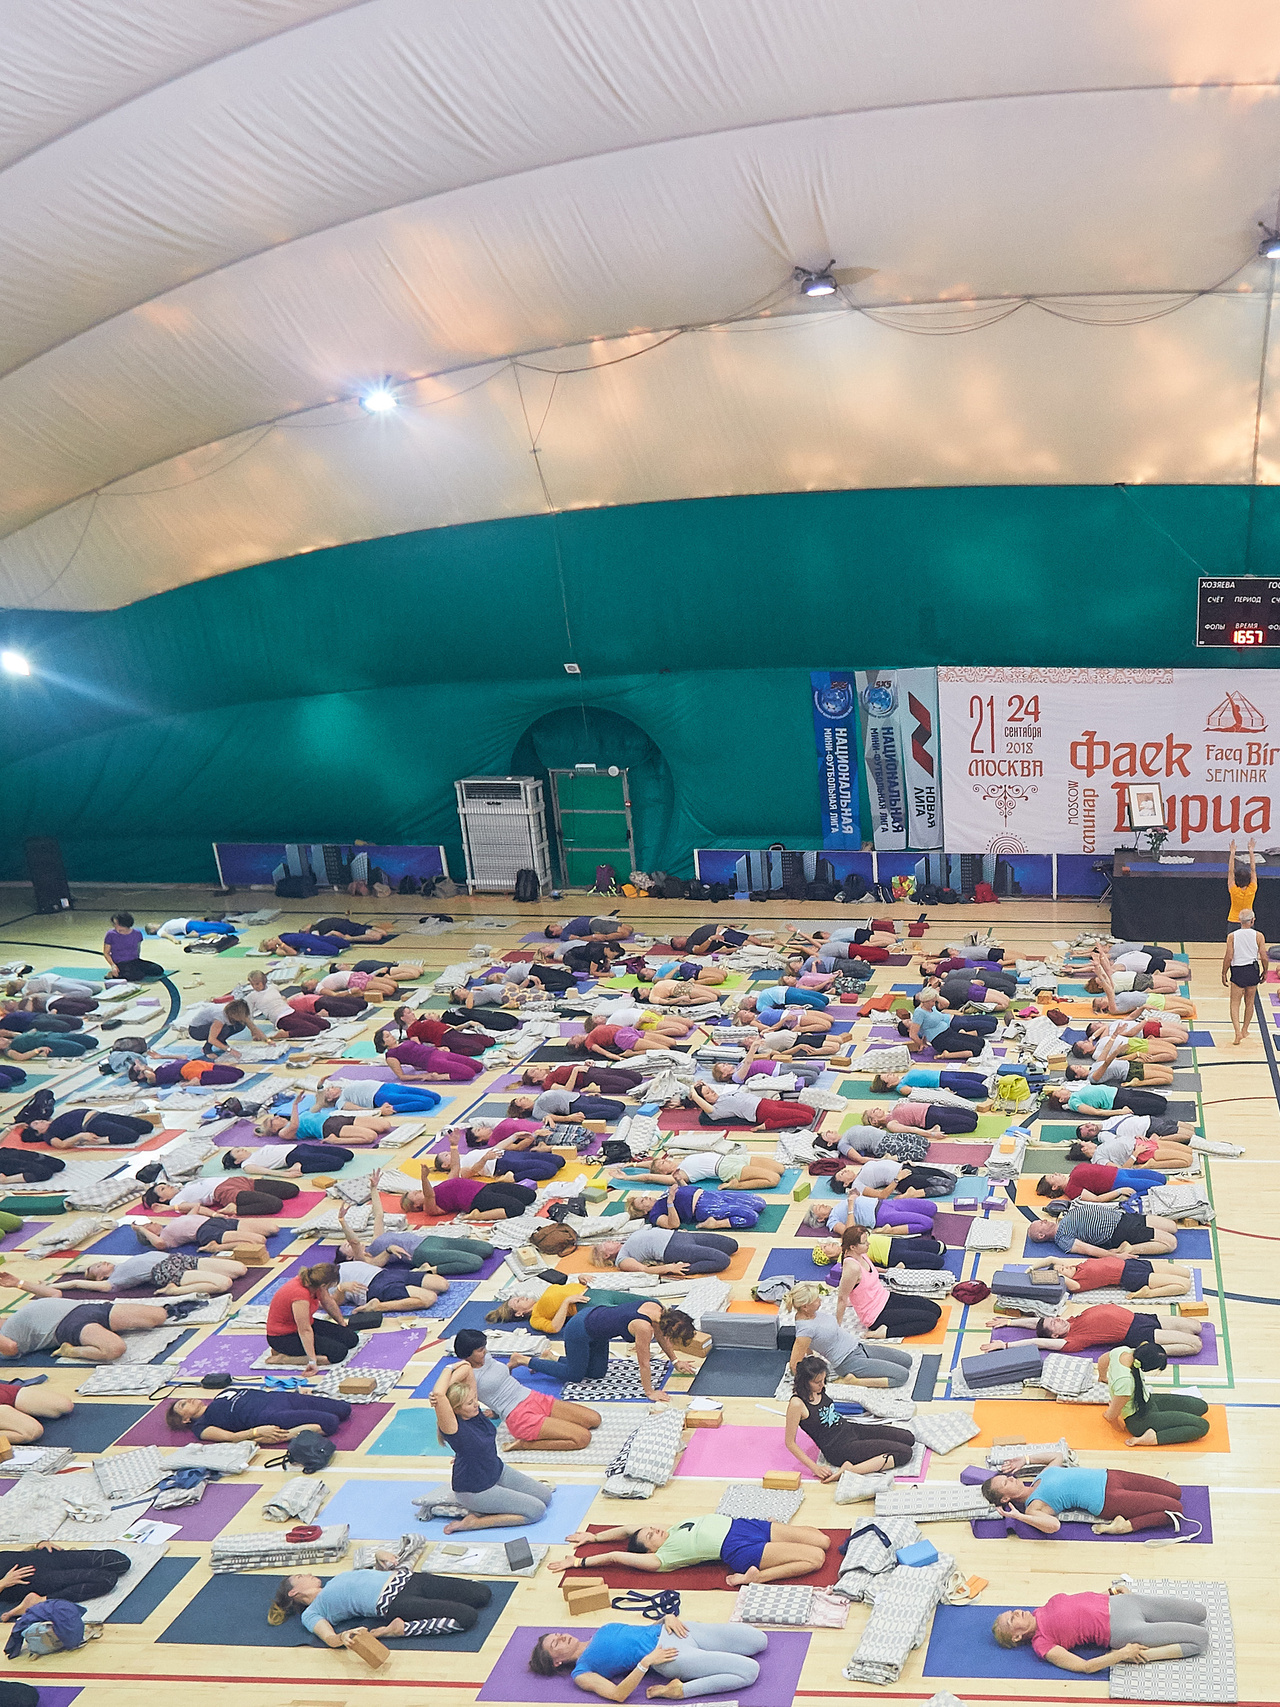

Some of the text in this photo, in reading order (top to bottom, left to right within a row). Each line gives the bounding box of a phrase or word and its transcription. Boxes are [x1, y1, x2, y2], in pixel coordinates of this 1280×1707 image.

[1201, 581, 1235, 589] ХОЗЯЕВА
[1234, 596, 1262, 604] ПЕРИОД
[969, 694, 995, 754] 21
[1007, 694, 1041, 723] 24
[1004, 723, 1042, 740] сентября
[1006, 741, 1034, 754] 2018
[968, 758, 1044, 777] МОСКВА
[1070, 730, 1192, 778] Фаек
[1205, 743, 1243, 765] Faeq
[823, 727, 840, 833] МИНИ-ФУТБОЛЬНАЯ ЛИГА
[835, 727, 854, 834] НАЦИОНАЛЬНАЯ
[870, 727, 886, 809] МИНИ-ФУТБОЛЬНАЯ
[880, 811, 889, 832] ЛИГА
[882, 726, 904, 833] НАЦИОНАЛЬНАЯ
[1206, 768, 1268, 783] SEMINAR
[913, 787, 926, 817] ЛИГА
[925, 786, 936, 828] НОВАЯ
[1068, 780, 1079, 825] MOSCOW
[1082, 788, 1099, 854] еминар
